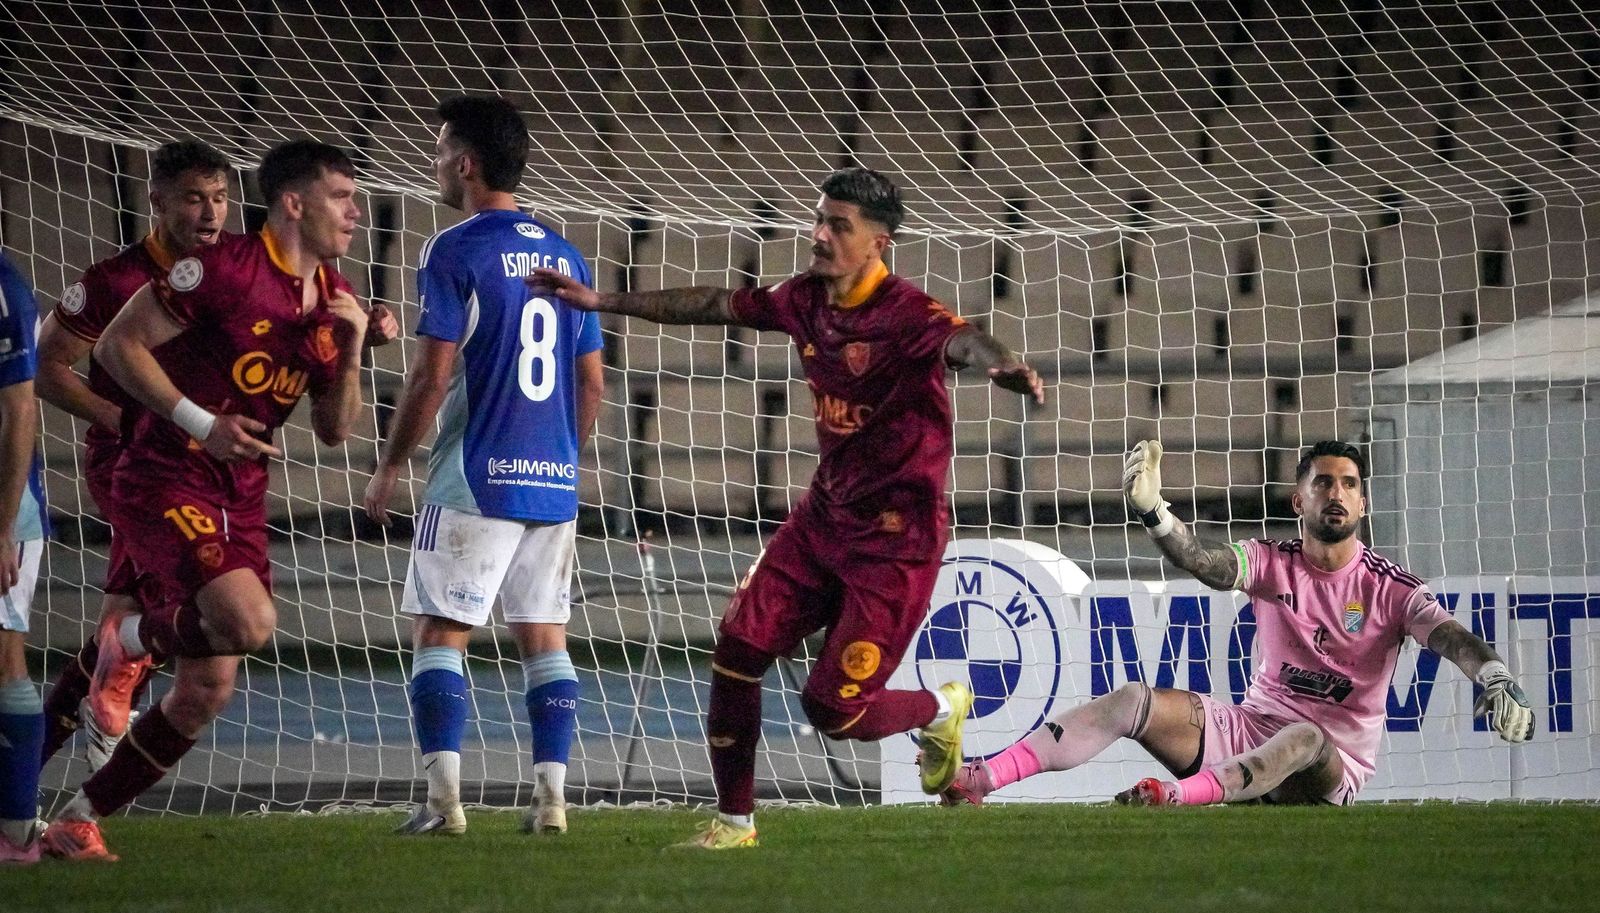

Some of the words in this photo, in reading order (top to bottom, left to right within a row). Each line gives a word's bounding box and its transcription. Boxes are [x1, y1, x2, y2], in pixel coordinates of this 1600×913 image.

[501, 252, 540, 277] ISMA
[518, 297, 557, 401] 8
[487, 478, 516, 486] Empresa
[163, 505, 216, 541] 18
[545, 696, 576, 710] XCD
